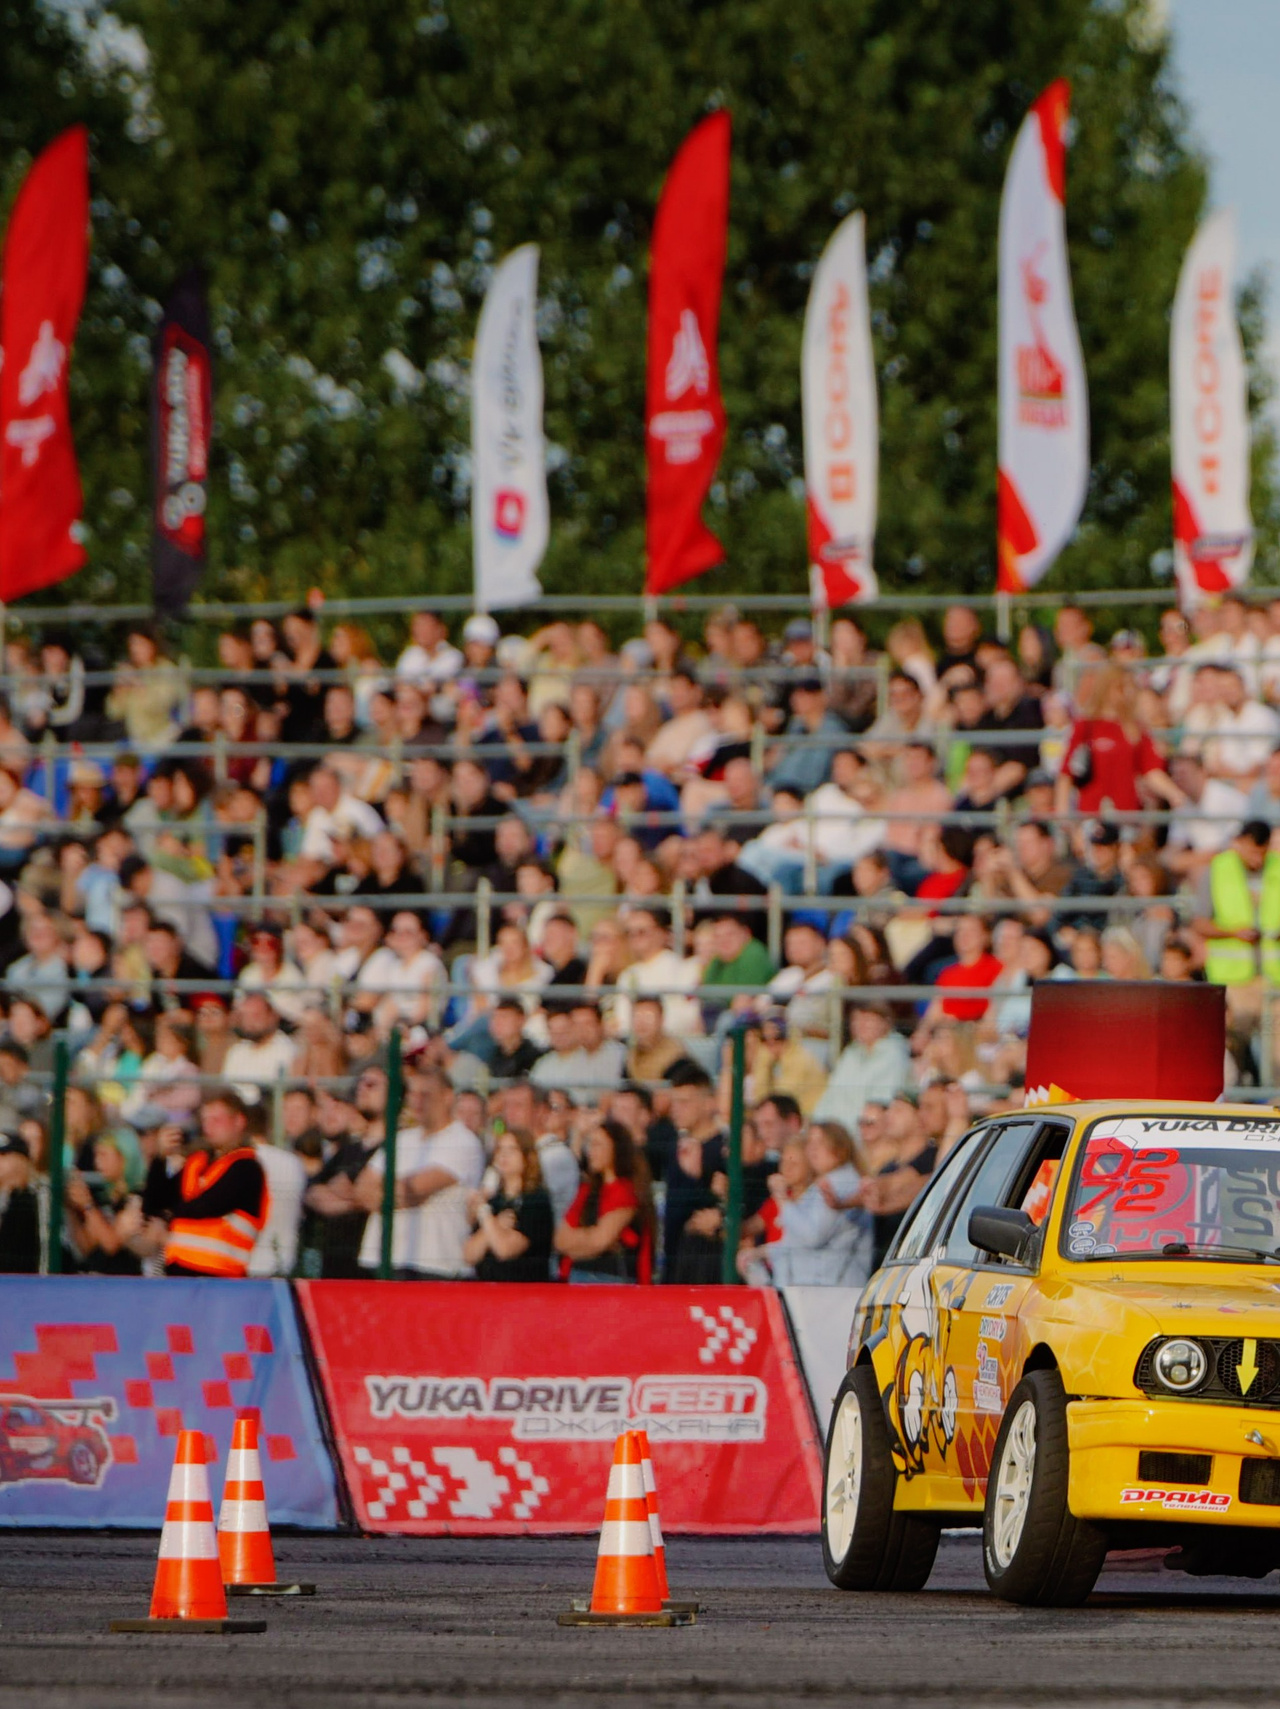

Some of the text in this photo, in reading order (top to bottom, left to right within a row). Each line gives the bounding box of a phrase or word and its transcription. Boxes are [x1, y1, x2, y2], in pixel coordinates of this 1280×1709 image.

[1140, 1120, 1219, 1134] YUKA
[1081, 1148, 1180, 1182] 02
[1074, 1178, 1166, 1216] 72
[372, 1382, 756, 1413] YUKA DRIVE FEST
[521, 1416, 760, 1435] ДЖИМХАНА
[1122, 1490, 1231, 1505] ДРАЙВ
